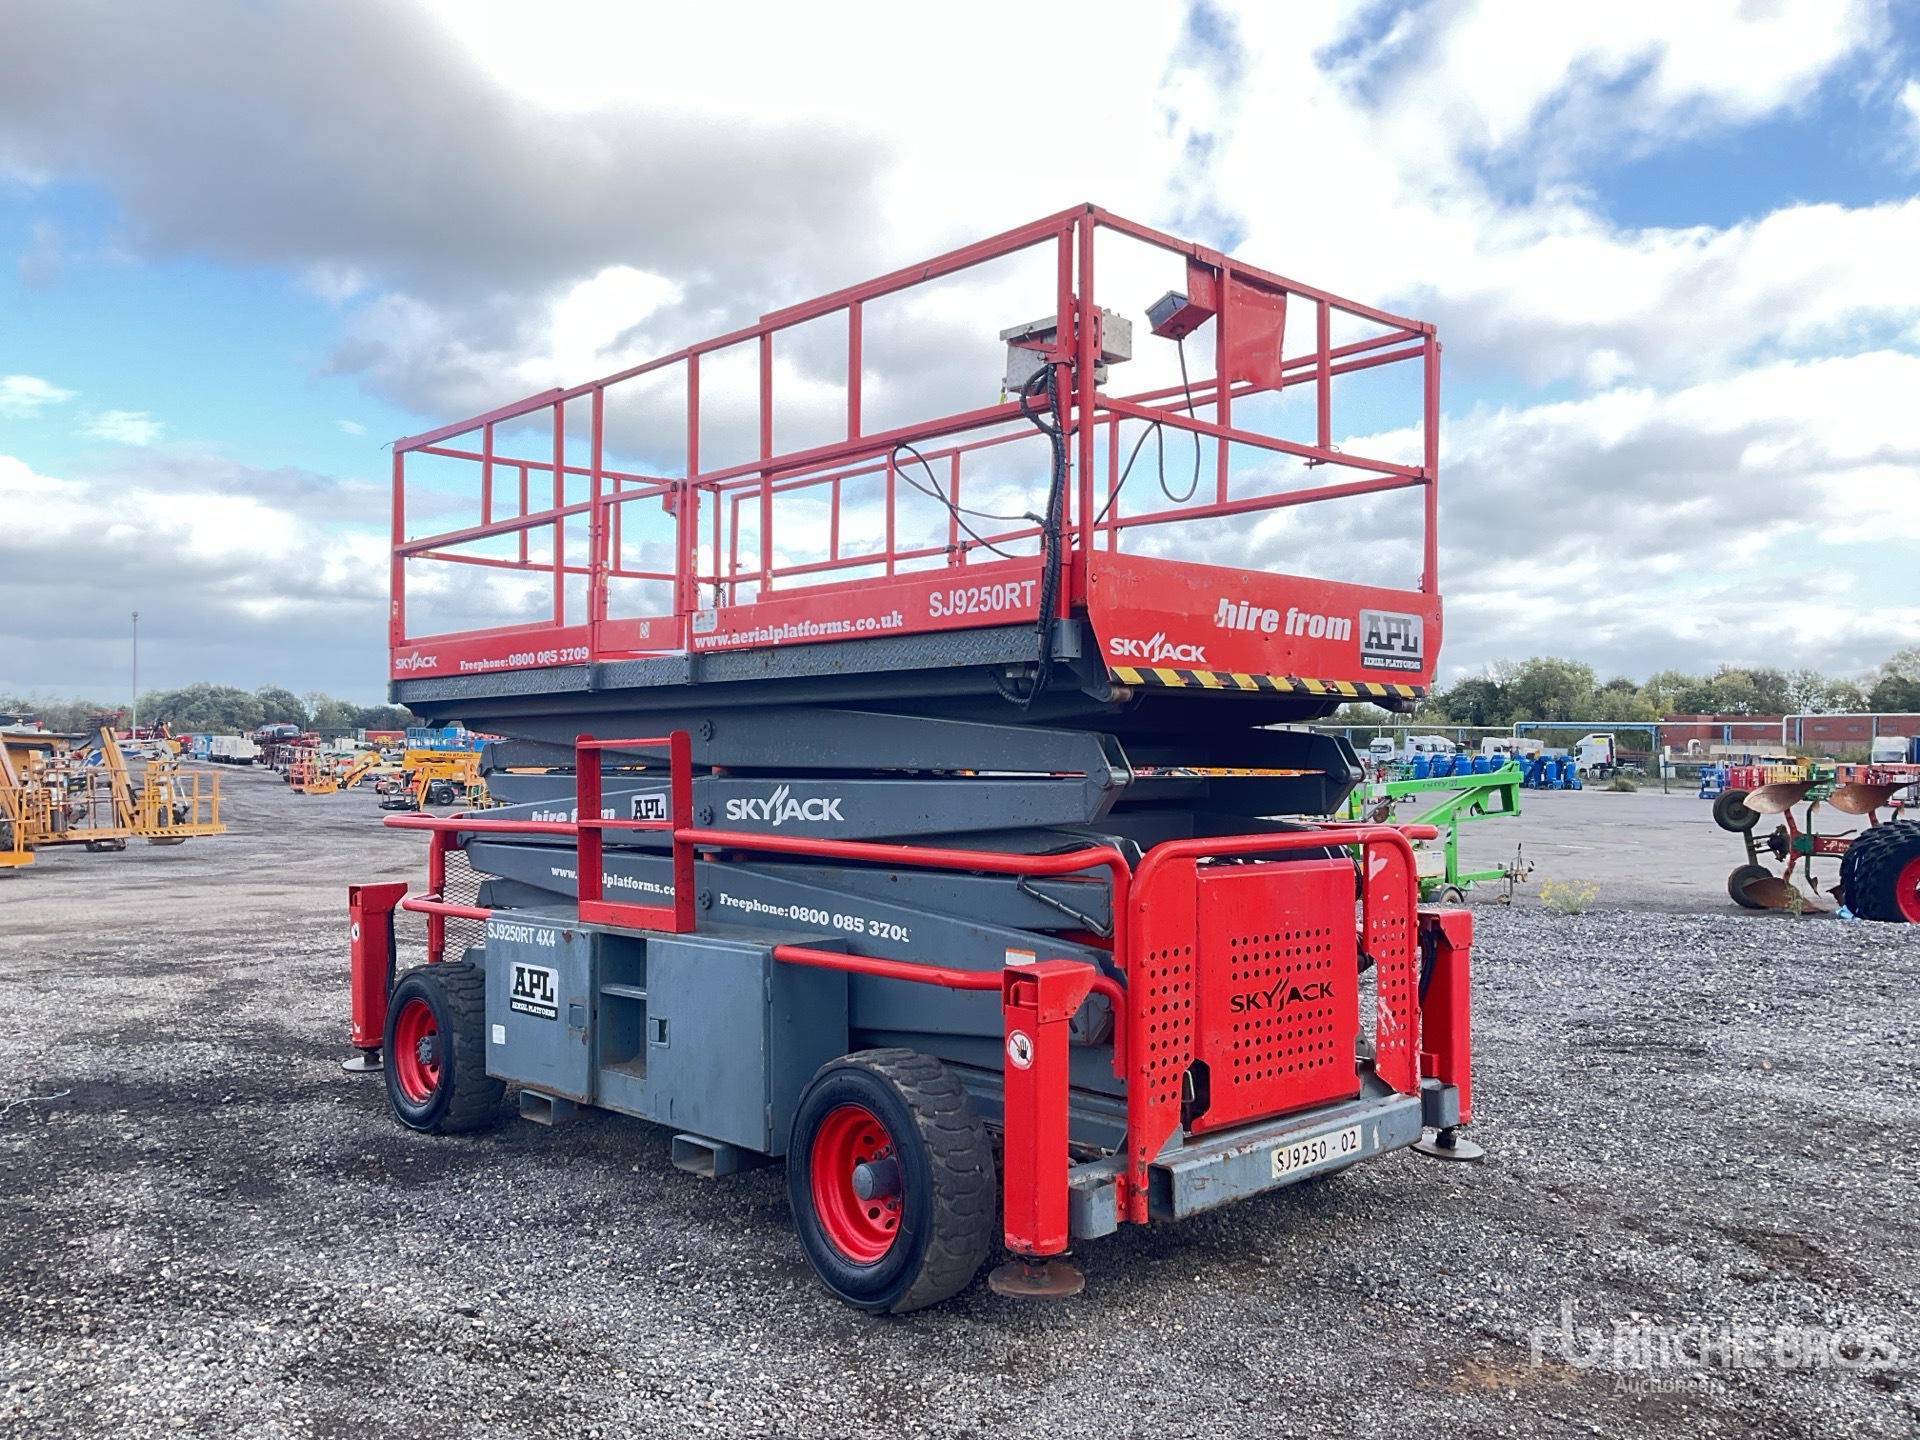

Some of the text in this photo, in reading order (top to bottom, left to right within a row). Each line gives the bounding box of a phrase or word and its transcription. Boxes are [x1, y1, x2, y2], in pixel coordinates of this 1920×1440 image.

[929, 580, 1036, 618] SJ9250RT
[695, 611, 903, 648] www.aerialplatforms.co.uk
[1215, 598, 1351, 641] hire from
[1365, 614, 1418, 653] APL
[395, 651, 437, 671] SKYJACK
[537, 650, 557, 665] 085
[560, 646, 589, 661] 3709
[1109, 631, 1207, 664] SKYJACK
[1363, 657, 1421, 670] AERIAL PLATFORMS
[532, 808, 616, 823] hire fm
[633, 798, 665, 820] APL
[726, 784, 844, 826] SKYJACK
[487, 922, 556, 947] SJ9250RT 4X4
[833, 913, 865, 933] 085
[513, 966, 554, 1002] APL
[1230, 976, 1335, 1013] SKYJACK
[1341, 1130, 1357, 1152] 02
